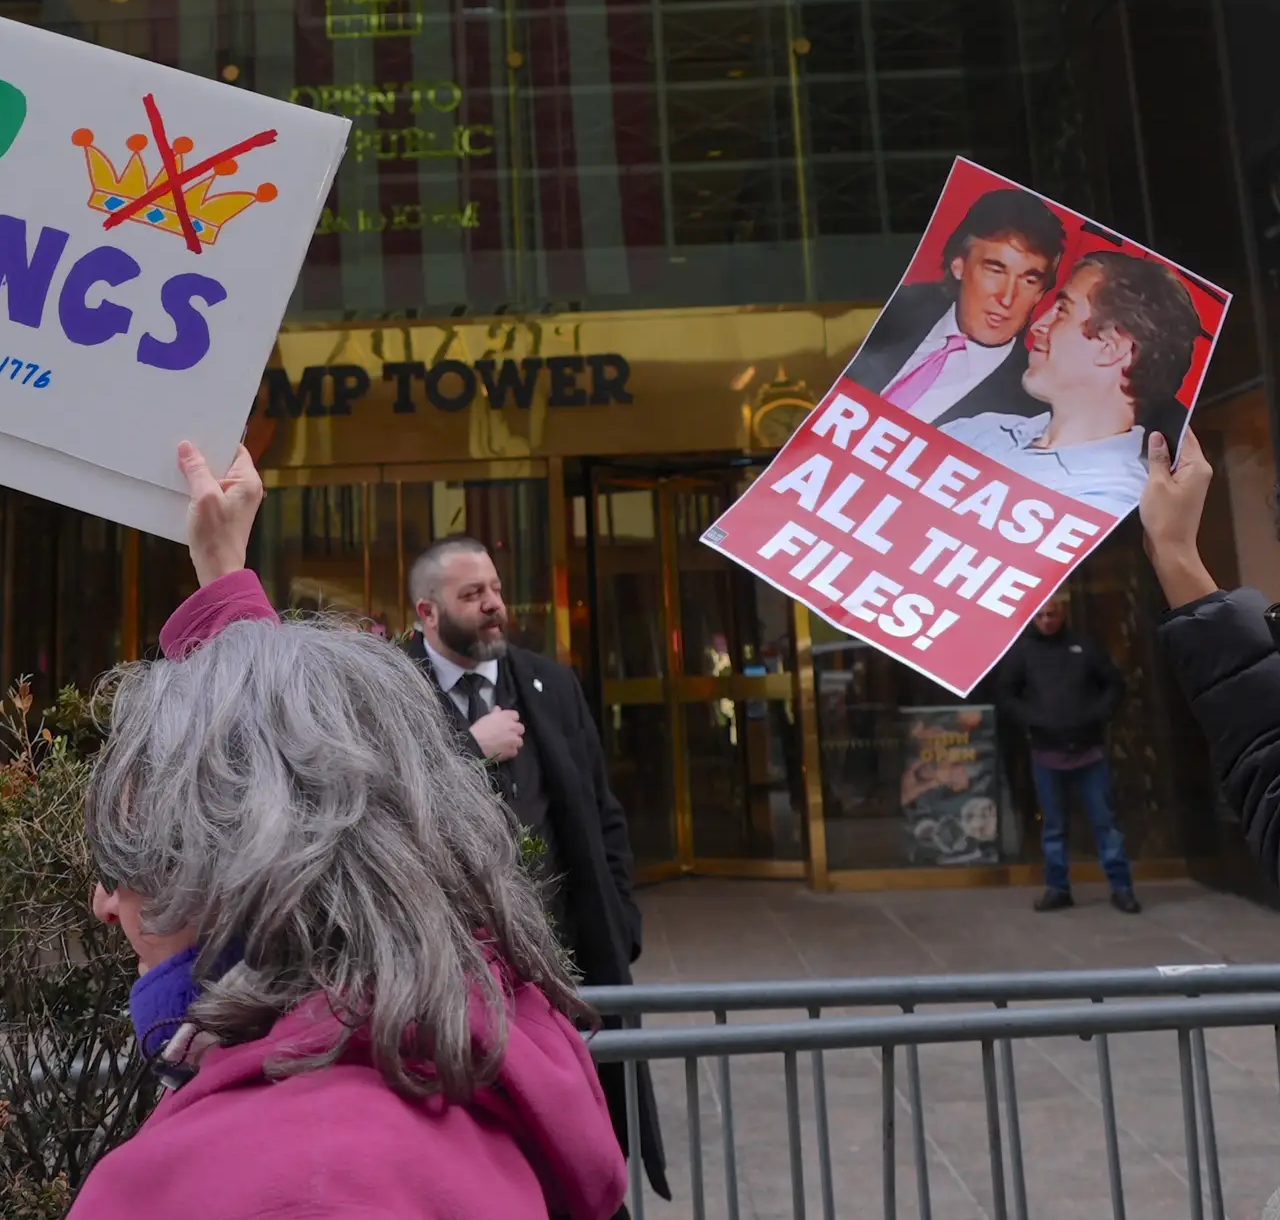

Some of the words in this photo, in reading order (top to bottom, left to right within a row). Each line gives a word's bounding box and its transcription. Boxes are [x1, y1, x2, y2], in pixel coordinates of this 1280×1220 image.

[382, 353, 634, 416] TOWER
[770, 452, 914, 555] ALL
[908, 526, 1042, 619] THE
[810, 392, 1100, 565] RELEASE
[757, 520, 961, 652] FILES!
